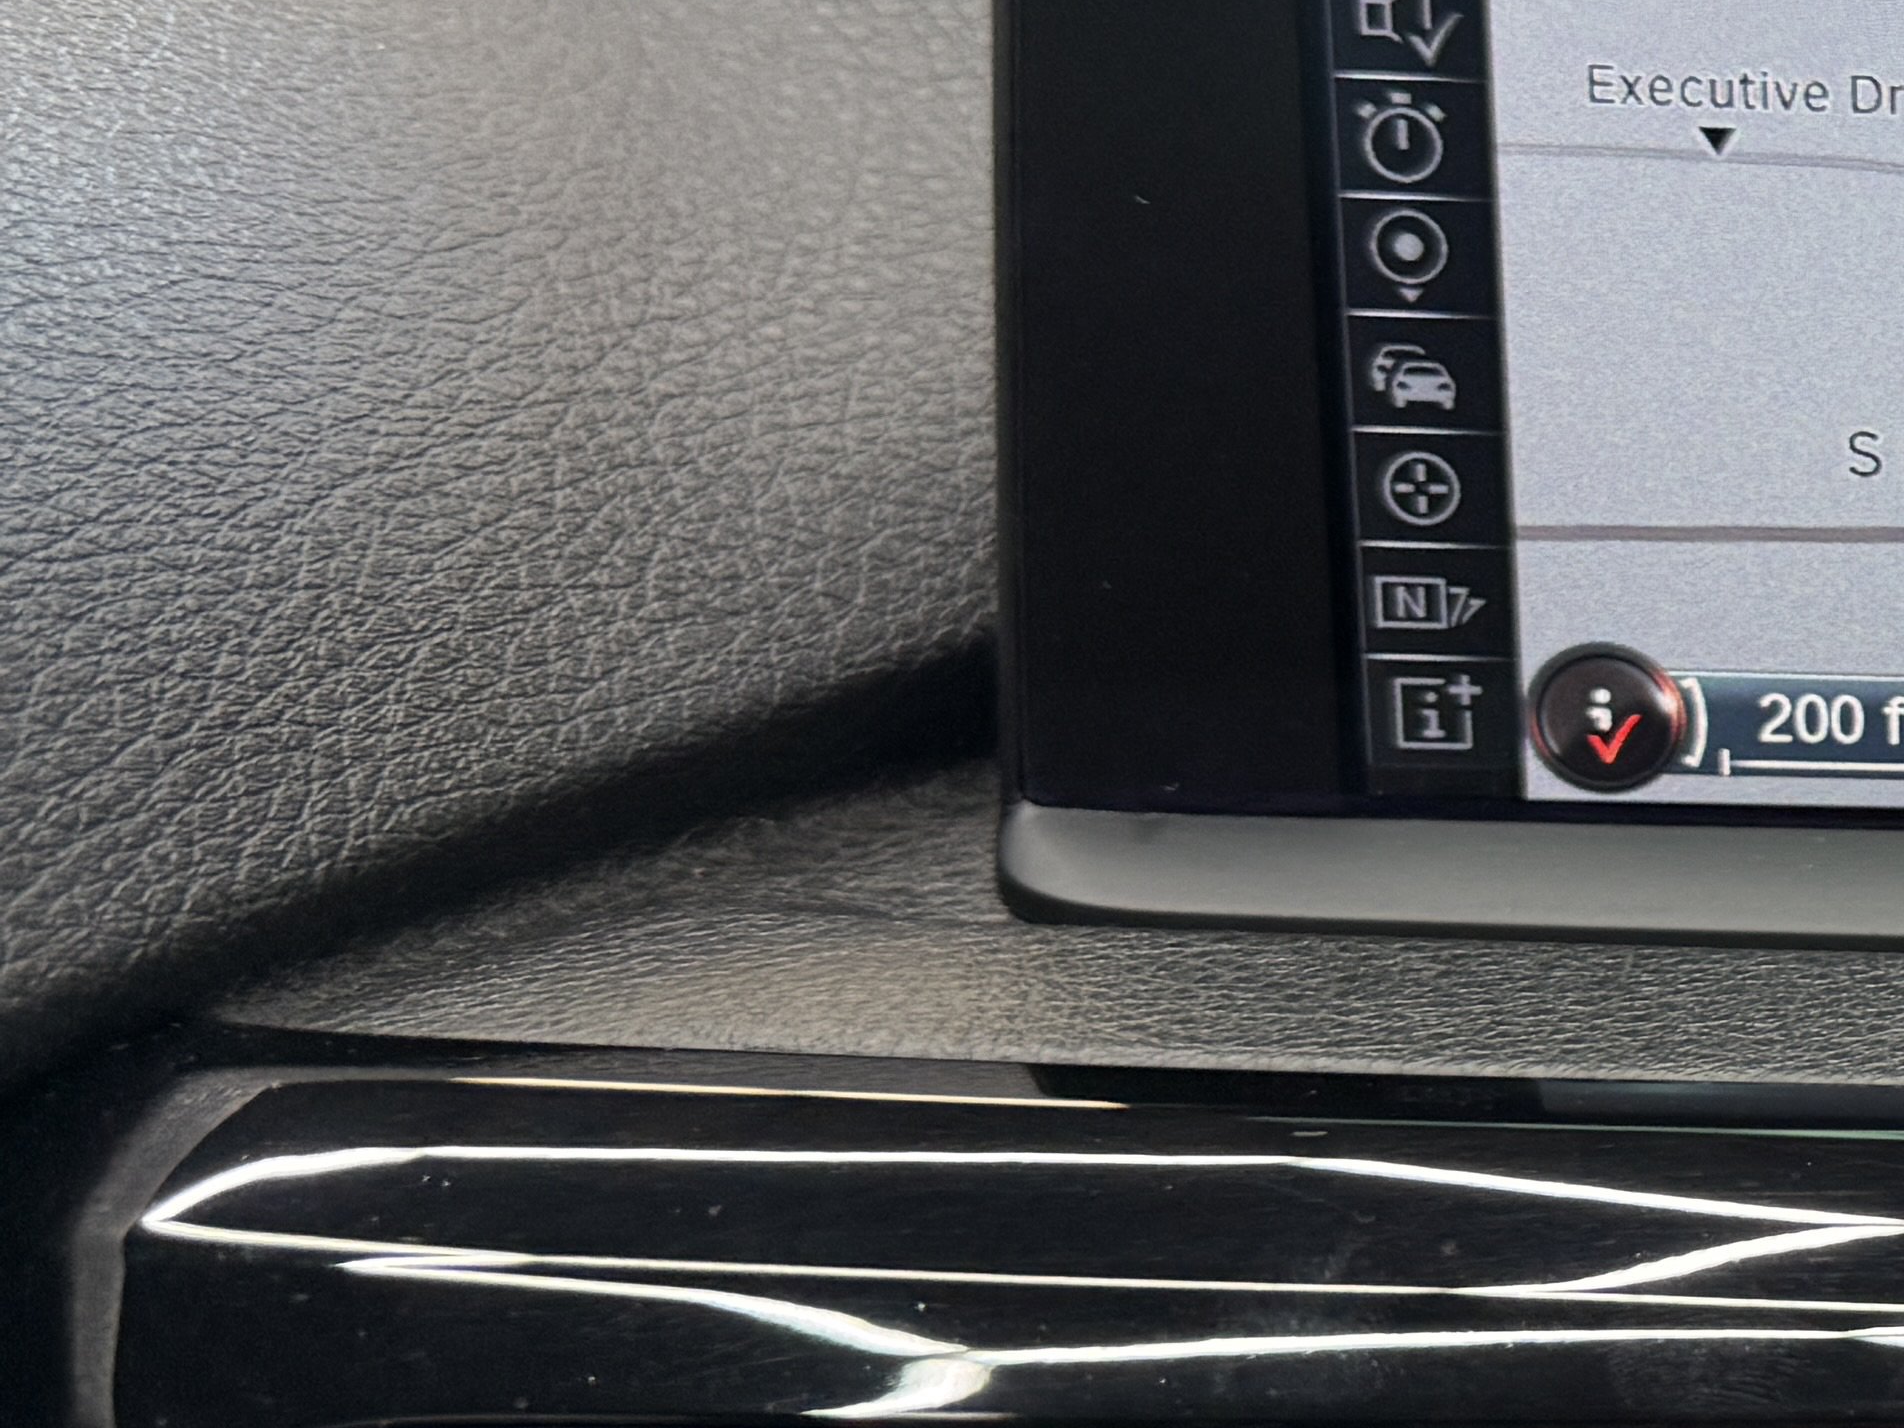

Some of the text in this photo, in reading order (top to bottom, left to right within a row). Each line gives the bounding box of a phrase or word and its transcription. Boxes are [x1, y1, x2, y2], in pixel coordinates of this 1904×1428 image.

[1586, 63, 1830, 113] Executive
[1846, 430, 1883, 478] S
[1757, 692, 1865, 745] 200
